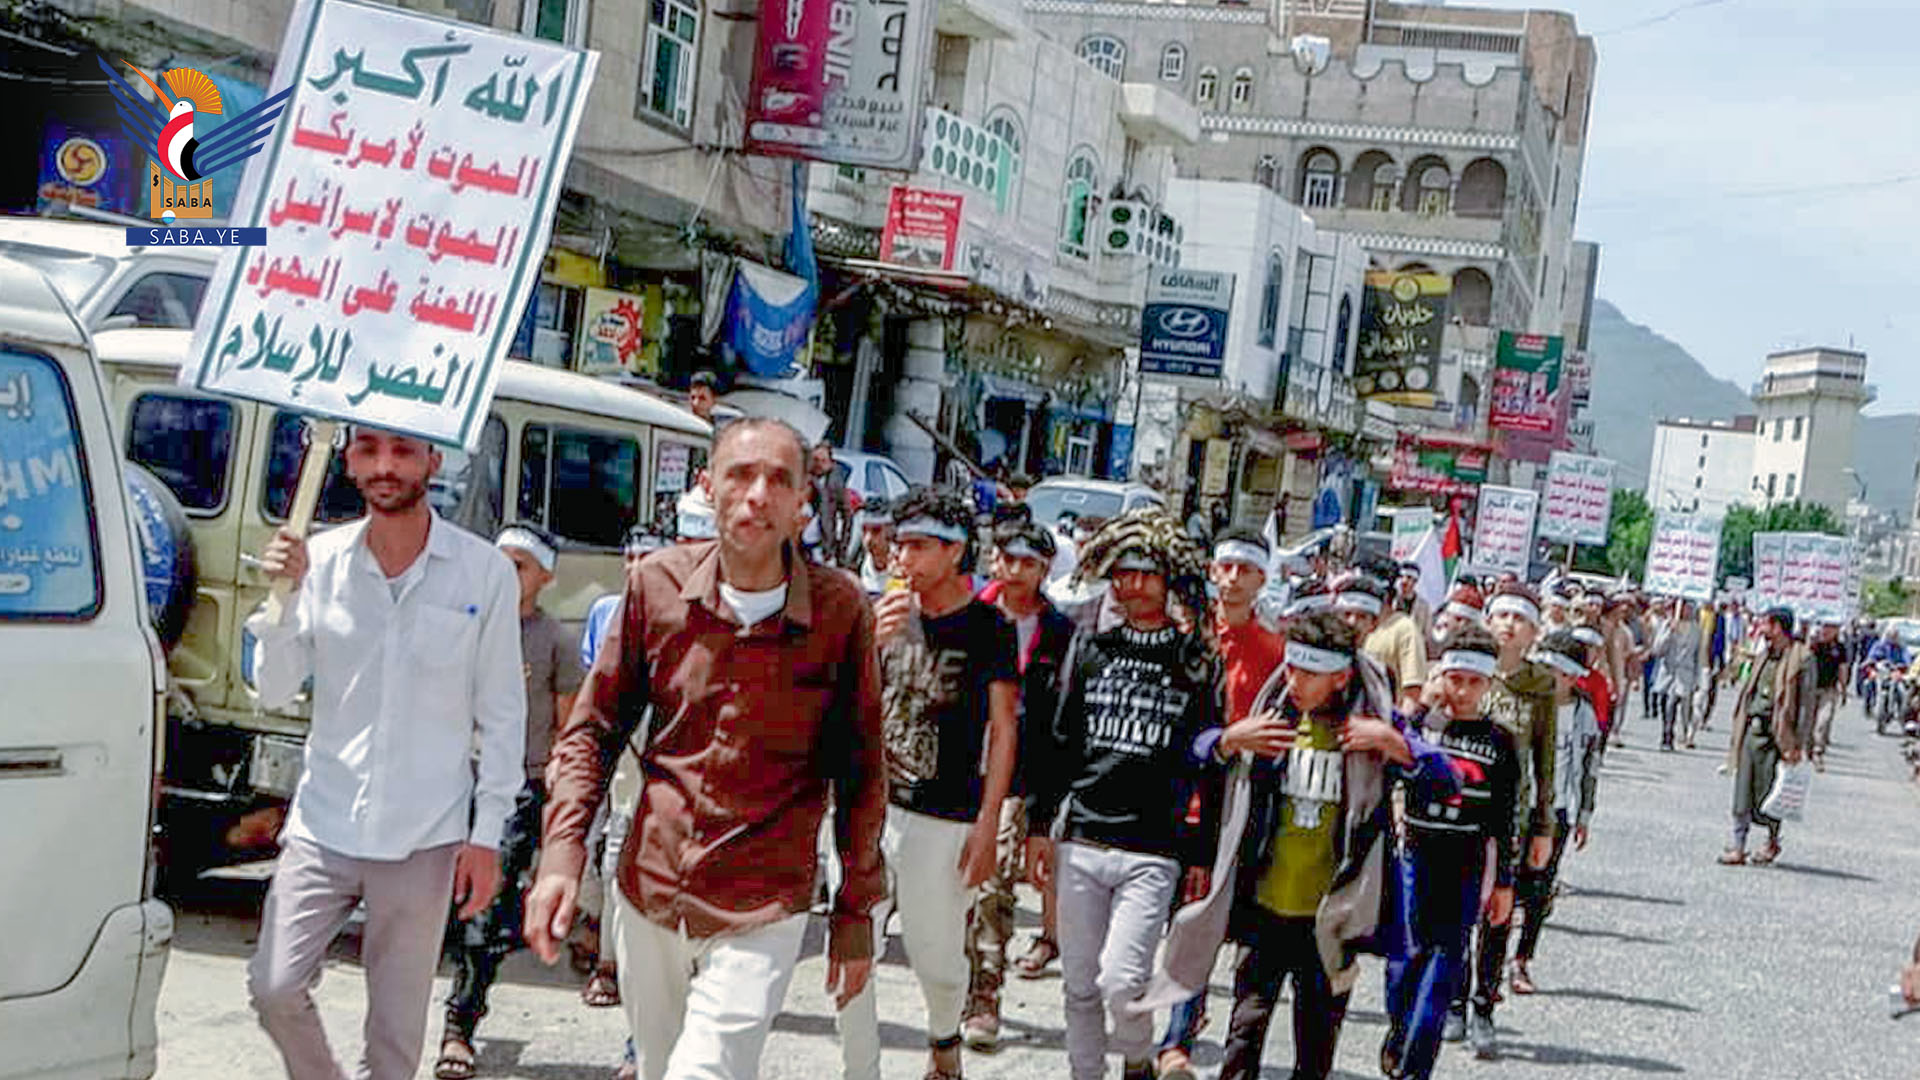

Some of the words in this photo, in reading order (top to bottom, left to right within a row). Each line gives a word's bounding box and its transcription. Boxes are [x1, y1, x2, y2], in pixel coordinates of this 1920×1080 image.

[306, 30, 473, 108] أكبر
[291, 104, 425, 170] لأمريكا
[426, 146, 541, 199] الموت
[268, 177, 403, 252] لإسرائيل
[404, 212, 520, 268] الموت
[246, 250, 342, 308] اليهود
[341, 268, 399, 317] على
[408, 275, 499, 338] اللعنة
[214, 308, 354, 398] للإسلام
[345, 341, 475, 408] النصر
